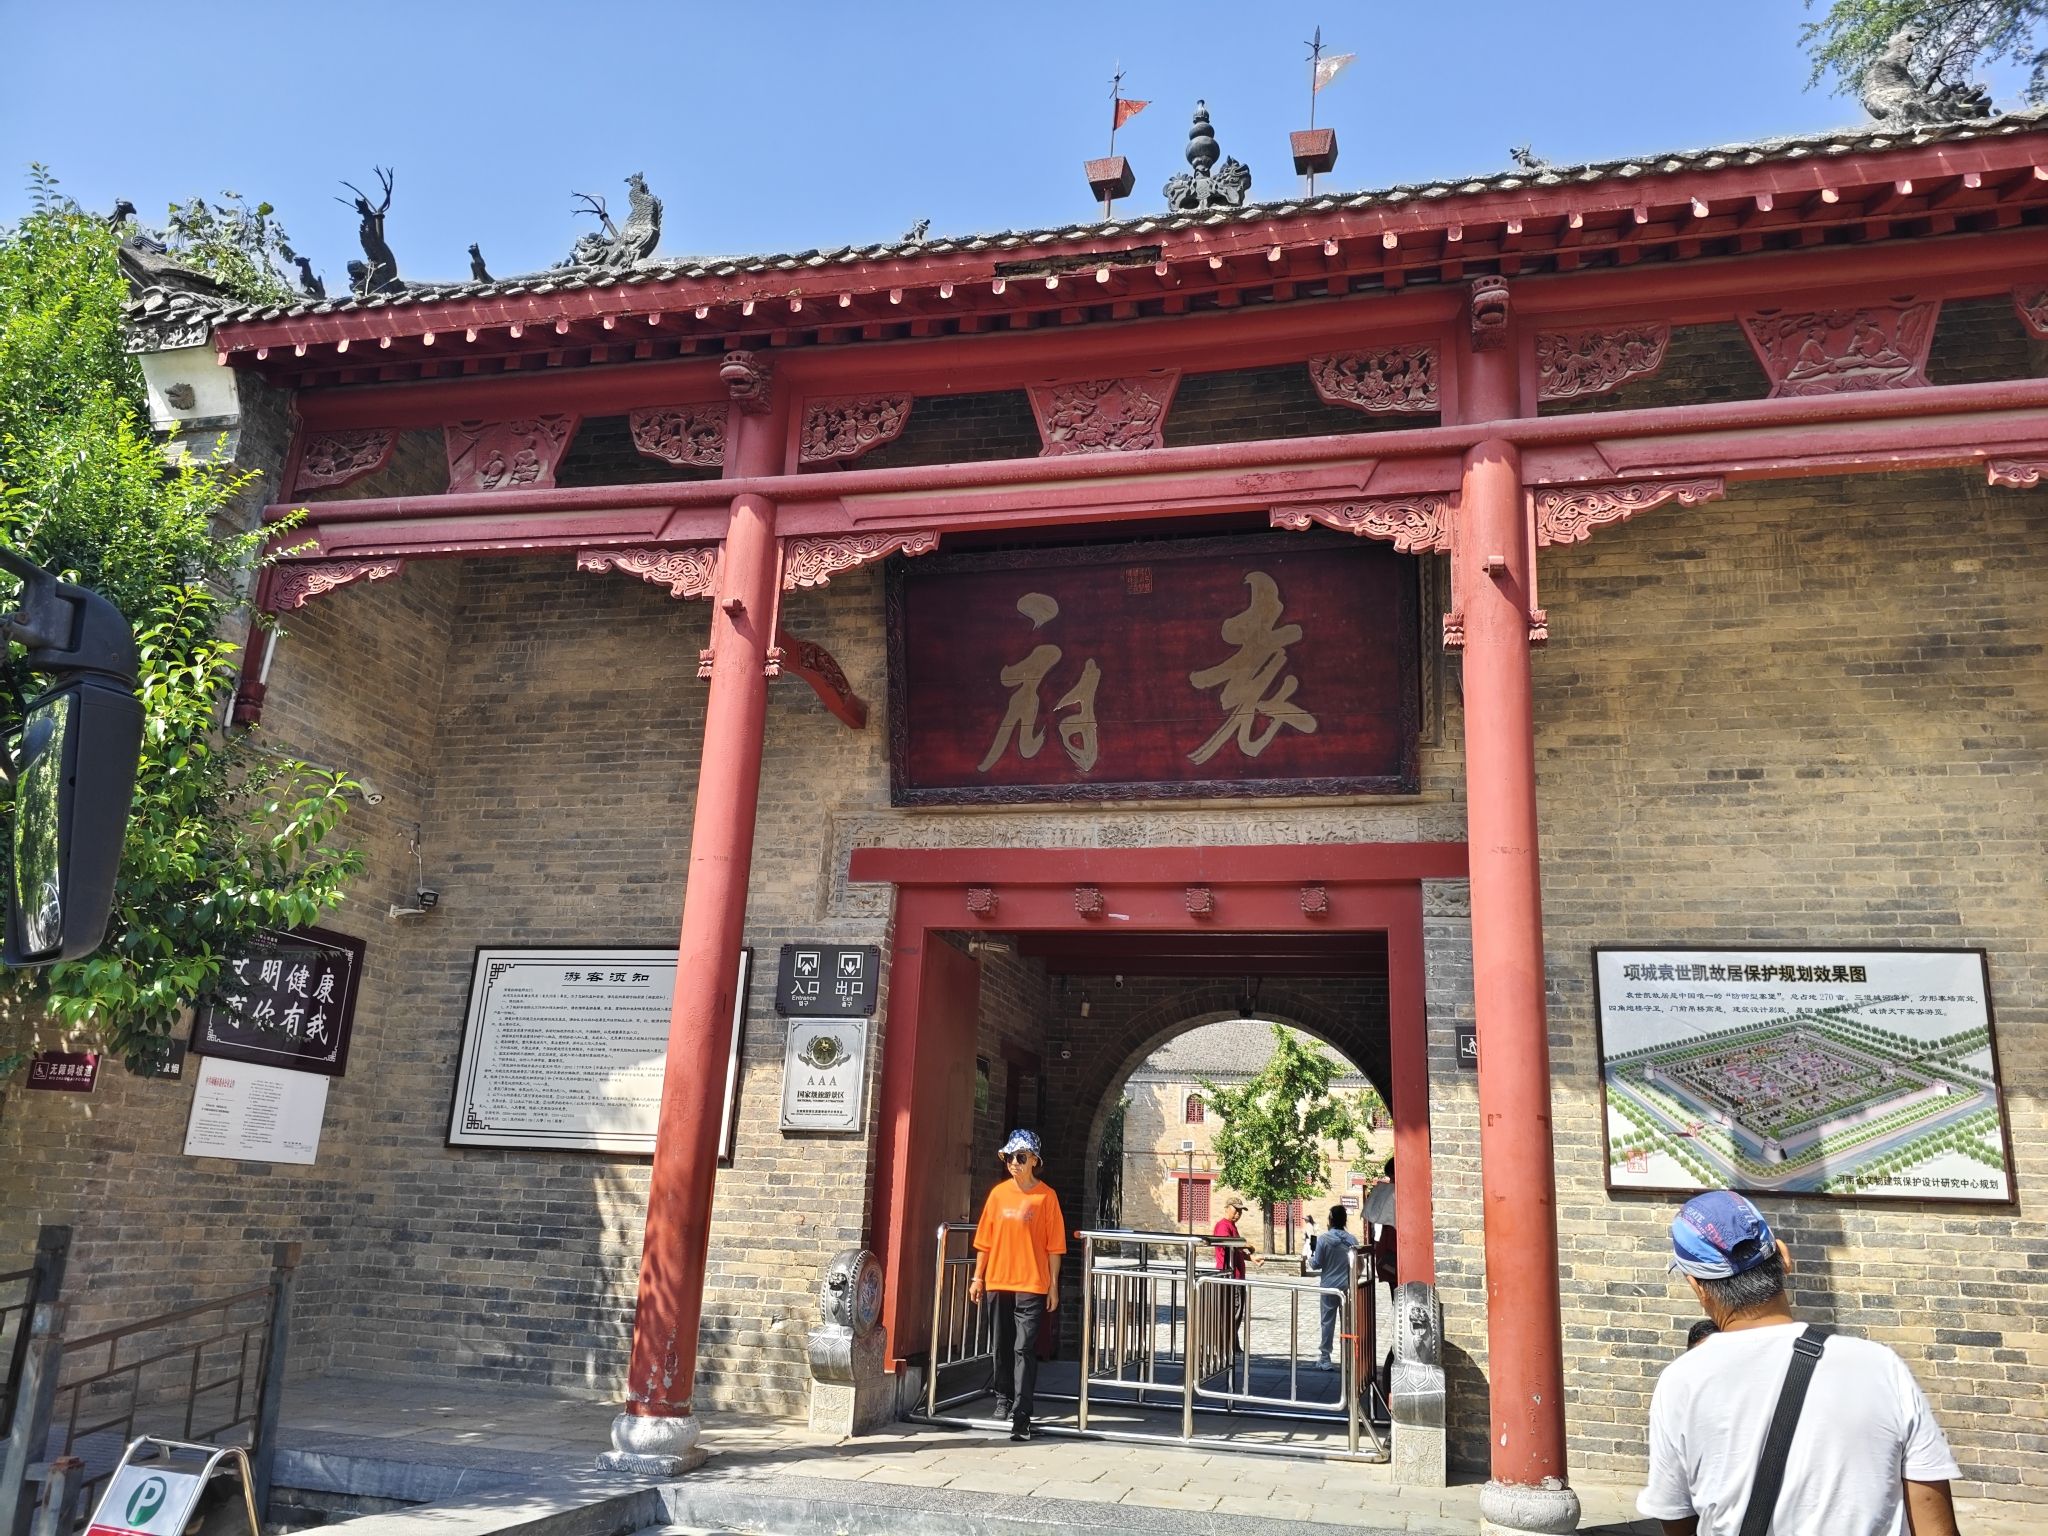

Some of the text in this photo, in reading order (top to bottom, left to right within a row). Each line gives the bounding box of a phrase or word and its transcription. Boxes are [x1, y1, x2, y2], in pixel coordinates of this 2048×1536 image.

[564, 971, 650, 983] 游客须知
[1623, 963, 1868, 983] 项城袁世凯故居保护规划效果图
[791, 980, 820, 994] 入口
[835, 980, 864, 996] 出口
[49, 1063, 93, 1077] 无障碍坡道
[796, 1090, 845, 1099] 国家级旅游景区
[128, 1479, 163, 1522] P
